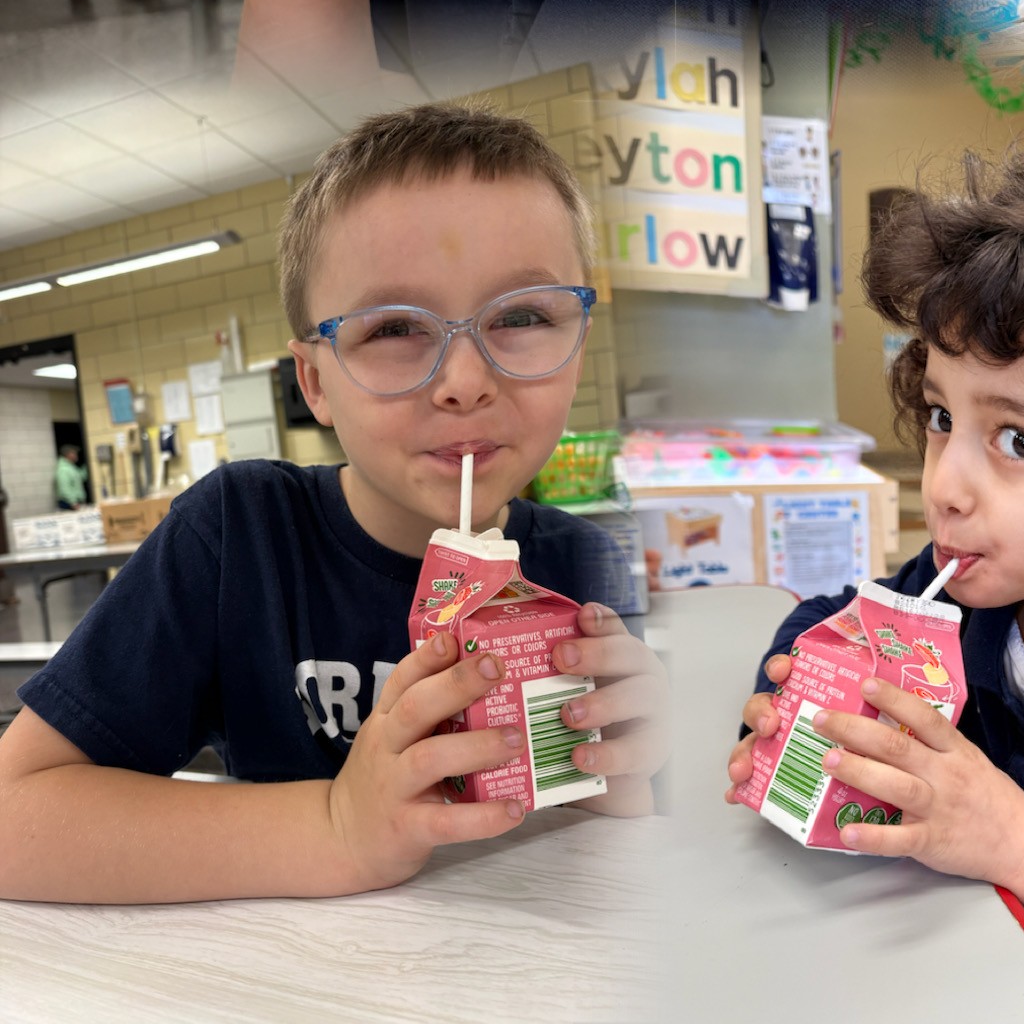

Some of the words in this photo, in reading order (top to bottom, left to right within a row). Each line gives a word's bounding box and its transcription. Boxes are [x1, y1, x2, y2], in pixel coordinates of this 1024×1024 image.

[617, 215, 743, 269] rlow
[433, 579, 458, 592] SHAKE
[488, 618, 511, 626] OPEN
[511, 615, 538, 625] OTHER
[479, 640, 490, 650] NO
[544, 626, 575, 639] ARTIFICIAL
[512, 645, 521, 655] OR
[523, 641, 548, 653] COLORS
[505, 657, 531, 669] SOURCE
[533, 654, 542, 664] OF
[515, 669, 521, 678] &
[522, 664, 550, 677] VITAMIN
[484, 686, 499, 697] IVE
[500, 683, 514, 693] AND
[485, 695, 507, 706] ACTIVE
[486, 703, 518, 717] PROBIOTIC
[481, 768, 509, 781] CALORIE
[510, 765, 528, 776] FOOD
[485, 782, 497, 791] SEE
[497, 776, 526, 789] NUTRITION
[487, 785, 525, 797] INFORMATION
